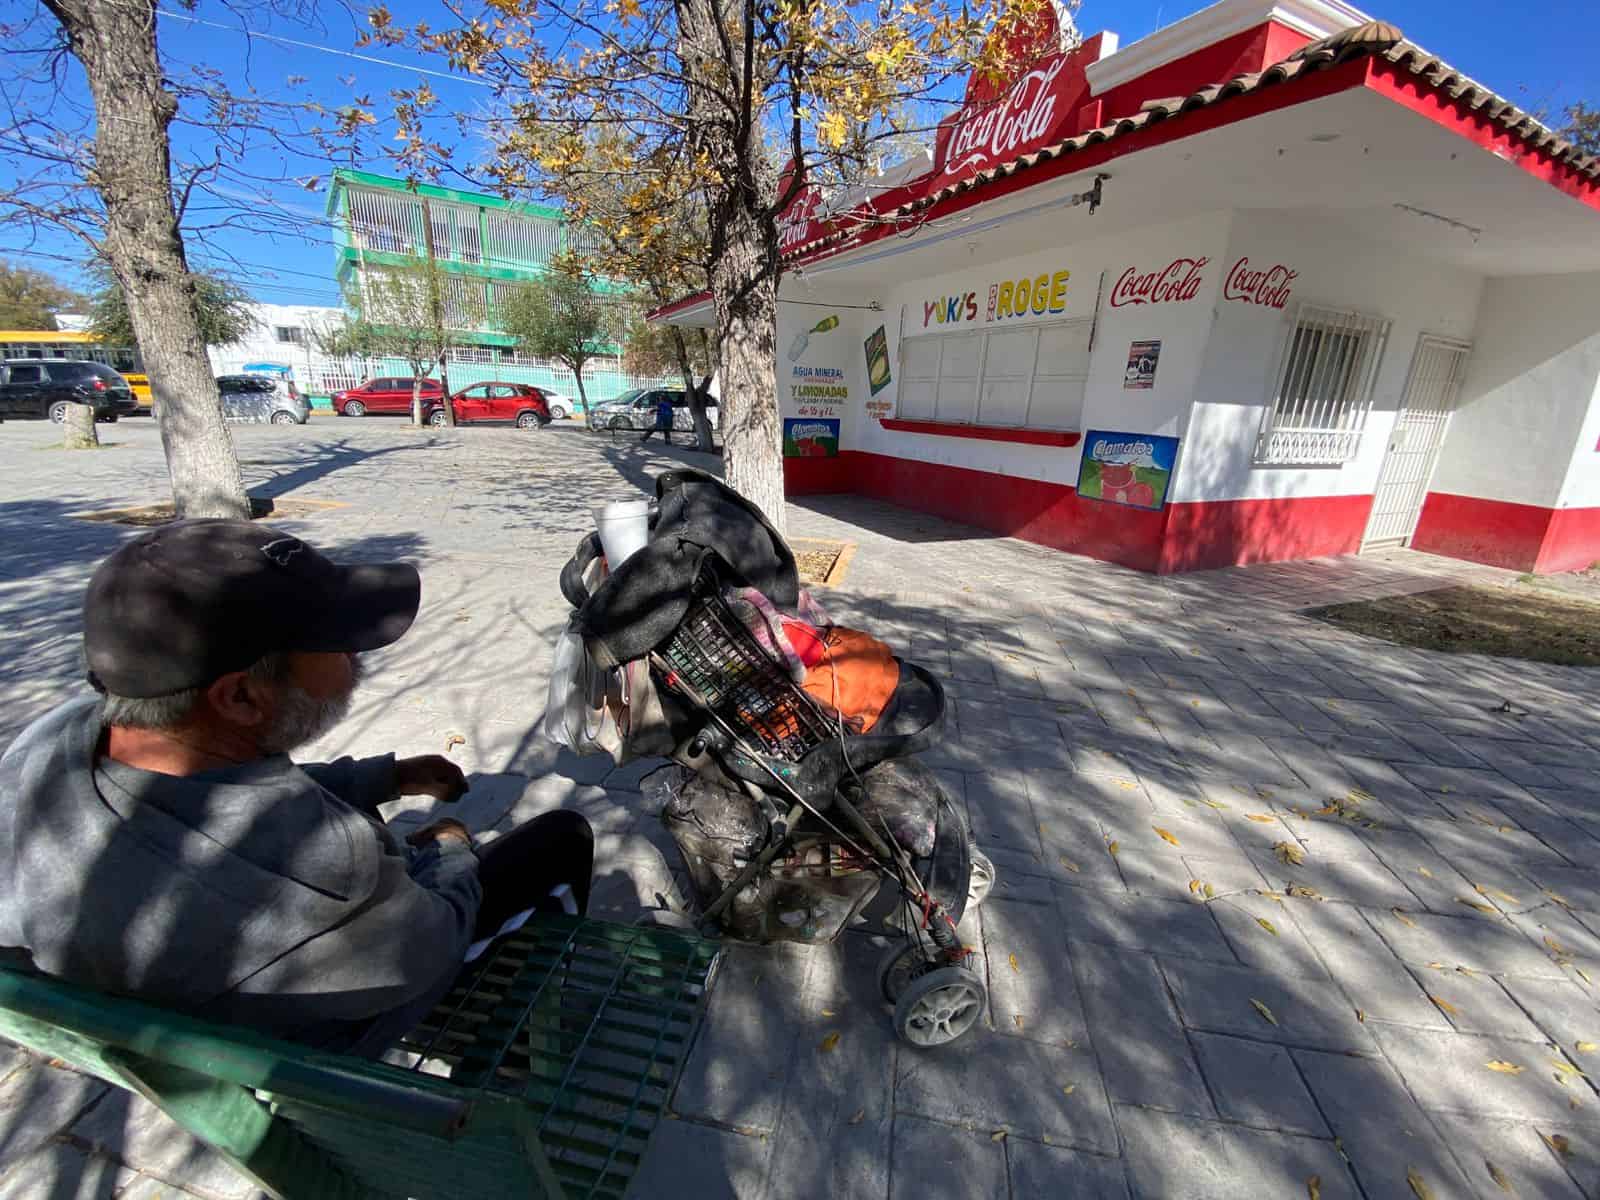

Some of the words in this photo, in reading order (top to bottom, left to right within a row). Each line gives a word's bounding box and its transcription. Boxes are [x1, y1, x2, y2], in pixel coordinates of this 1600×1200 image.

[997, 269, 1070, 320] ROGE
[792, 366, 813, 377] AGUA
[815, 367, 844, 379] MINERAL
[799, 385, 848, 398] LIMONADAS
